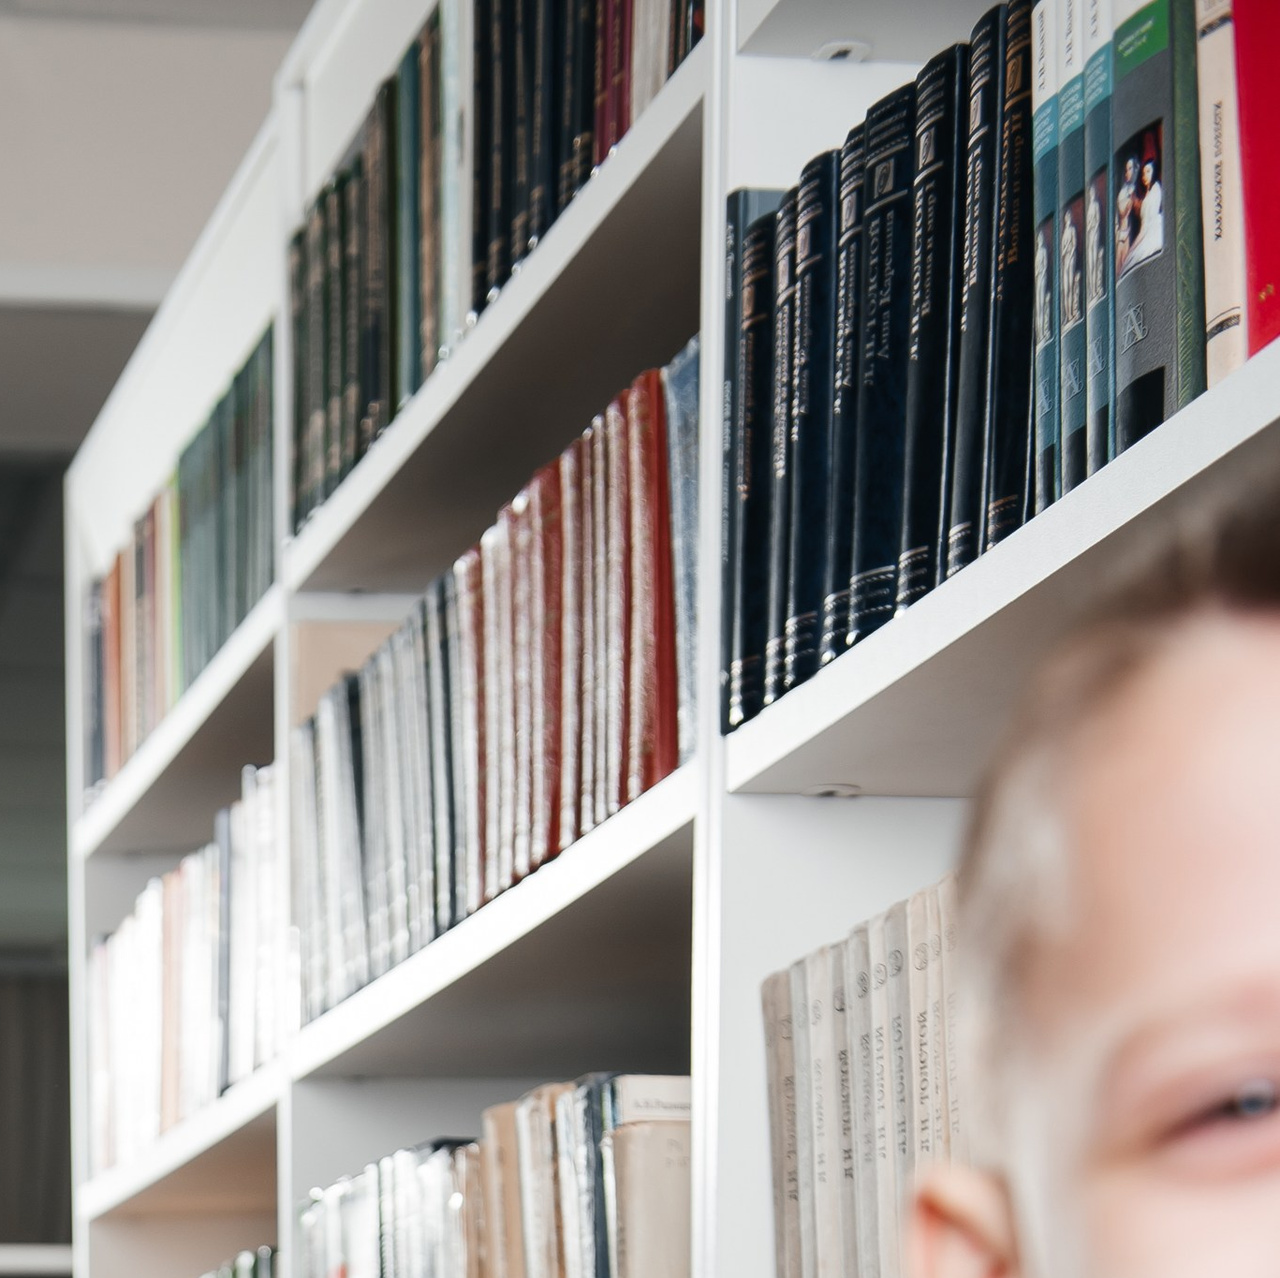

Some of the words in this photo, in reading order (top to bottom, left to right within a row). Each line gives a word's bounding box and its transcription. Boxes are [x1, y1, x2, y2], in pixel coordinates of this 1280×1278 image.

[865, 216, 882, 333] ТОЛСТОЙ
[878, 209, 896, 307] Каренина
[876, 309, 890, 360] Анна
[916, 1010, 930, 1107] ТОЛСТОЙ
